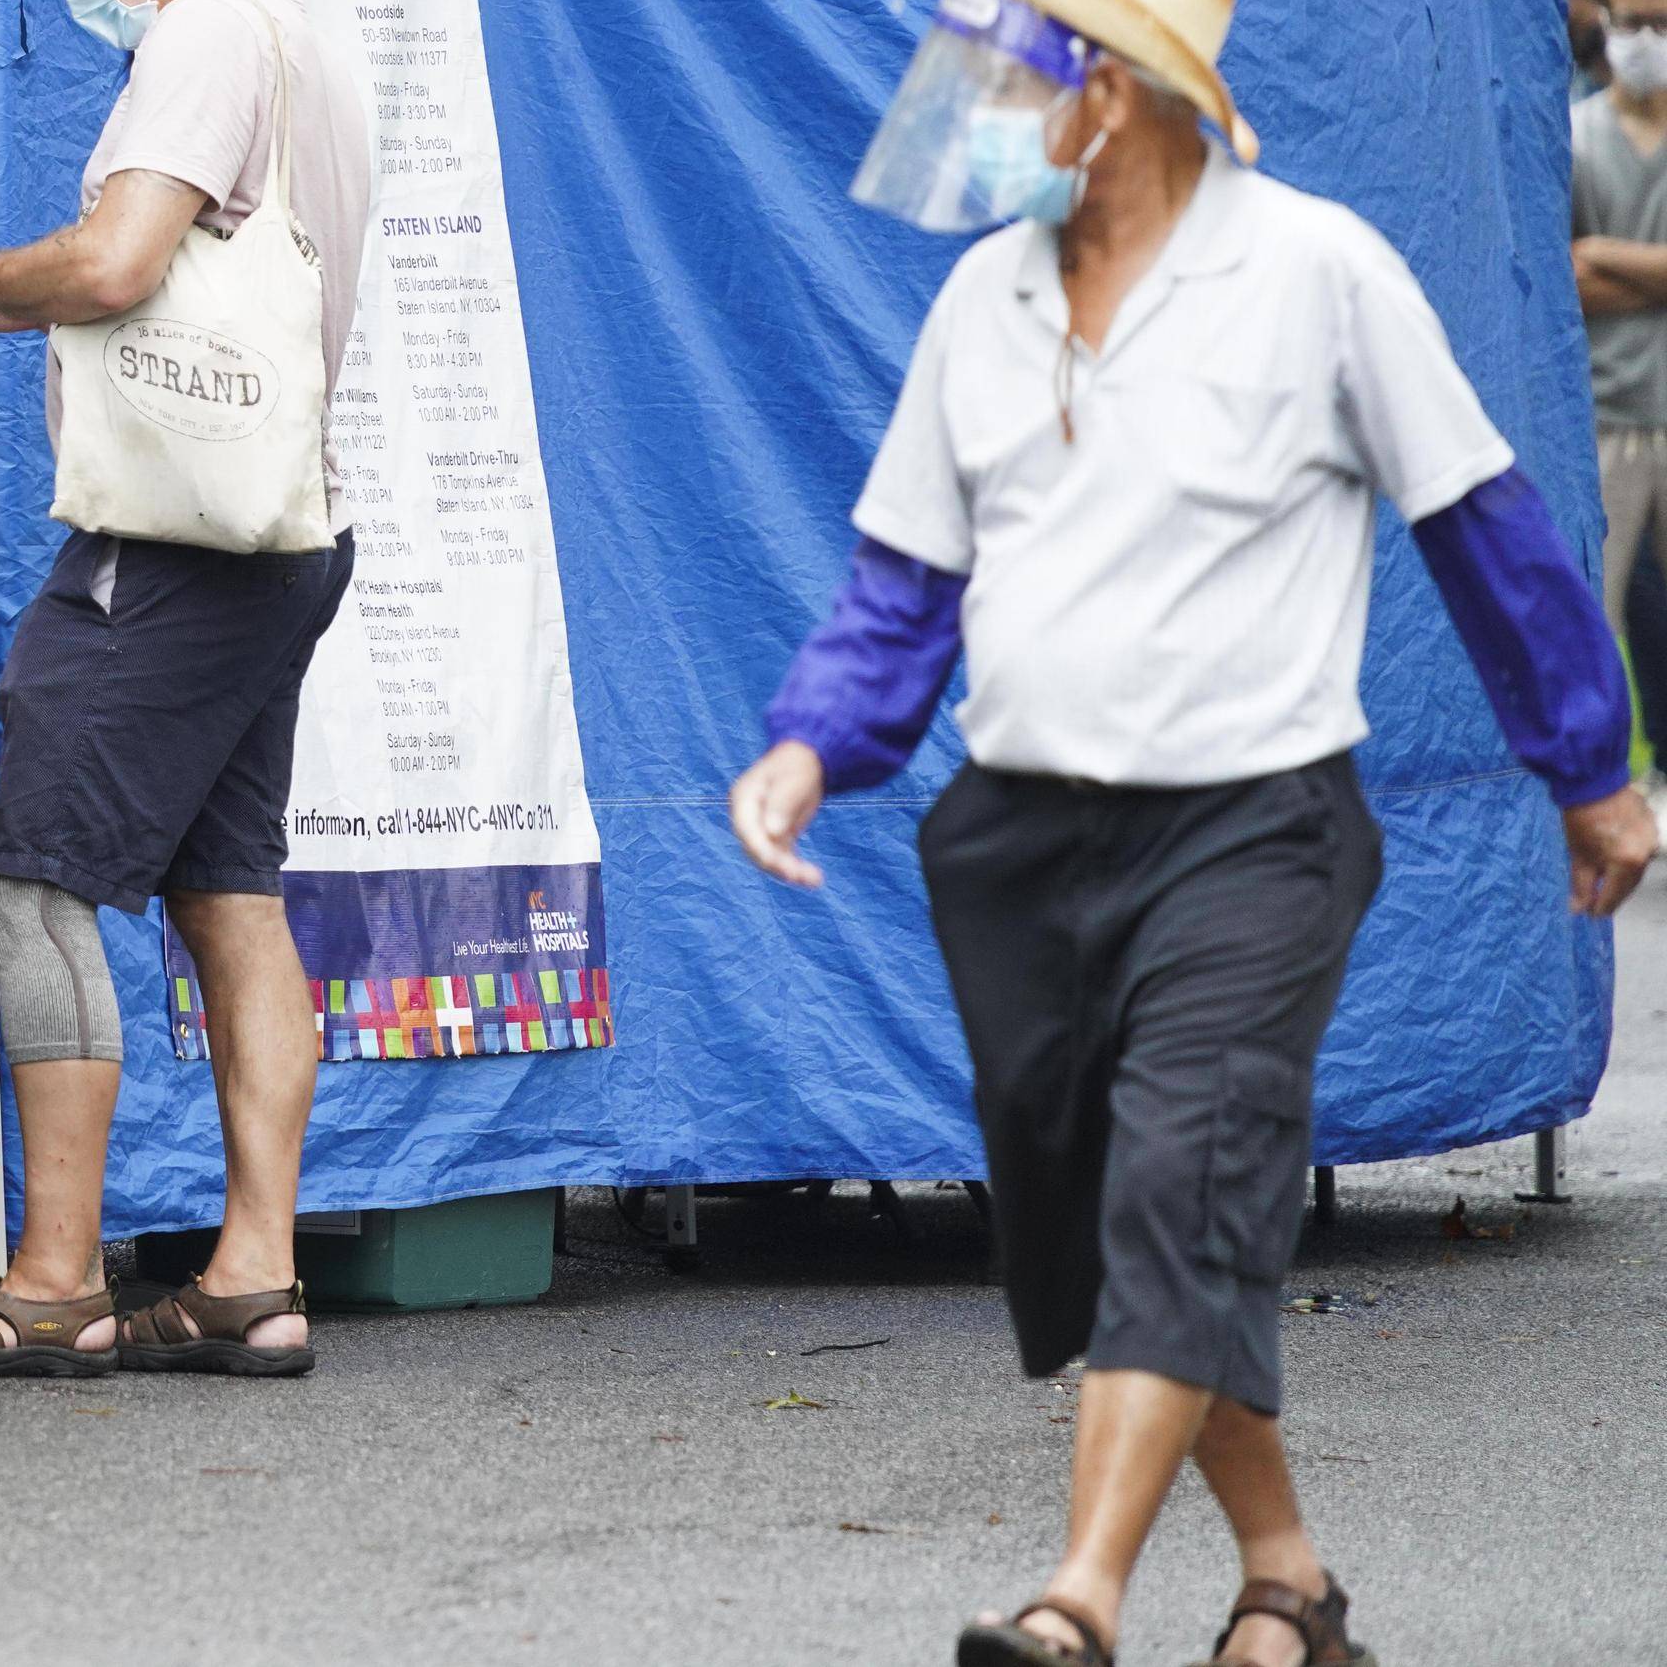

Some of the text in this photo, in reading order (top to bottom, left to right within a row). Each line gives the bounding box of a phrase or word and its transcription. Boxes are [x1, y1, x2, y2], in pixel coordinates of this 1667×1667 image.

[356, 4, 405, 21] Woodside
[362, 27, 390, 43] 50-53
[422, 27, 447, 43] Road
[420, 50, 447, 65] 11377
[404, 82, 430, 100] Friday
[377, 104, 446, 120] 9:00 AM 3:30 PM
[380, 135, 452, 154] Saturday Sunday
[398, 158, 413, 174] AM
[420, 158, 443, 173] 2:00
[445, 157, 462, 172] PM
[382, 215, 482, 236] STATEN ISLAND
[387, 253, 439, 269] Vanderbilt
[394, 275, 488, 293] 165 Vanderbilt Avenue
[397, 300, 426, 315] Staten
[473, 297, 501, 313] 10304
[137, 326, 243, 360] 18 miles of books
[402, 329, 470, 347] Monday Friday
[345, 351, 372, 366] 2:00 PM
[430, 352, 445, 366] AM
[451, 352, 467, 367] 4:30
[468, 352, 482, 366] PM
[120, 345, 262, 407] STRAND
[345, 388, 378, 404] Williams
[412, 383, 487, 401] Saturday Sunday
[419, 405, 499, 422] 10:00 AM 2:00 PM
[351, 436, 362, 450] NY
[364, 435, 386, 450] 11221
[427, 449, 518, 466] Vanderbilt Drive-Thru
[356, 465, 379, 484] Friday
[448, 474, 484, 492] Tompkins
[486, 474, 518, 488] Avenue
[379, 488, 393, 502] PM
[436, 498, 460, 513] Staten
[510, 494, 534, 510] 10304
[372, 519, 400, 537] Sunday
[440, 527, 508, 546] Monday Friday
[363, 542, 374, 556] AM
[379, 542, 395, 557] 2:00
[396, 542, 413, 555] PM
[467, 551, 481, 565] AM
[487, 550, 507, 565] 3:00
[508, 548, 525, 563] PM
[354, 580, 367, 594] NYC
[368, 580, 393, 594] Health
[359, 602, 414, 618] Gotham Health
[381, 625, 404, 644] Coney
[406, 625, 432, 640] Island
[401, 648, 414, 662] NY
[411, 678, 436, 696] Friday
[382, 700, 450, 717] 9:00 AM 7:00 PM
[387, 731, 454, 751] Saturday Sunday
[390, 754, 461, 772] 10:00 AM 2:00 PM
[377, 808, 403, 834] call
[405, 803, 525, 834] 1-844-NYC-4NYC
[527, 810, 536, 831] or
[528, 890, 547, 910] NYC
[453, 941, 468, 956] Live
[468, 940, 489, 955] Your
[532, 931, 589, 952] HOSPITALS
